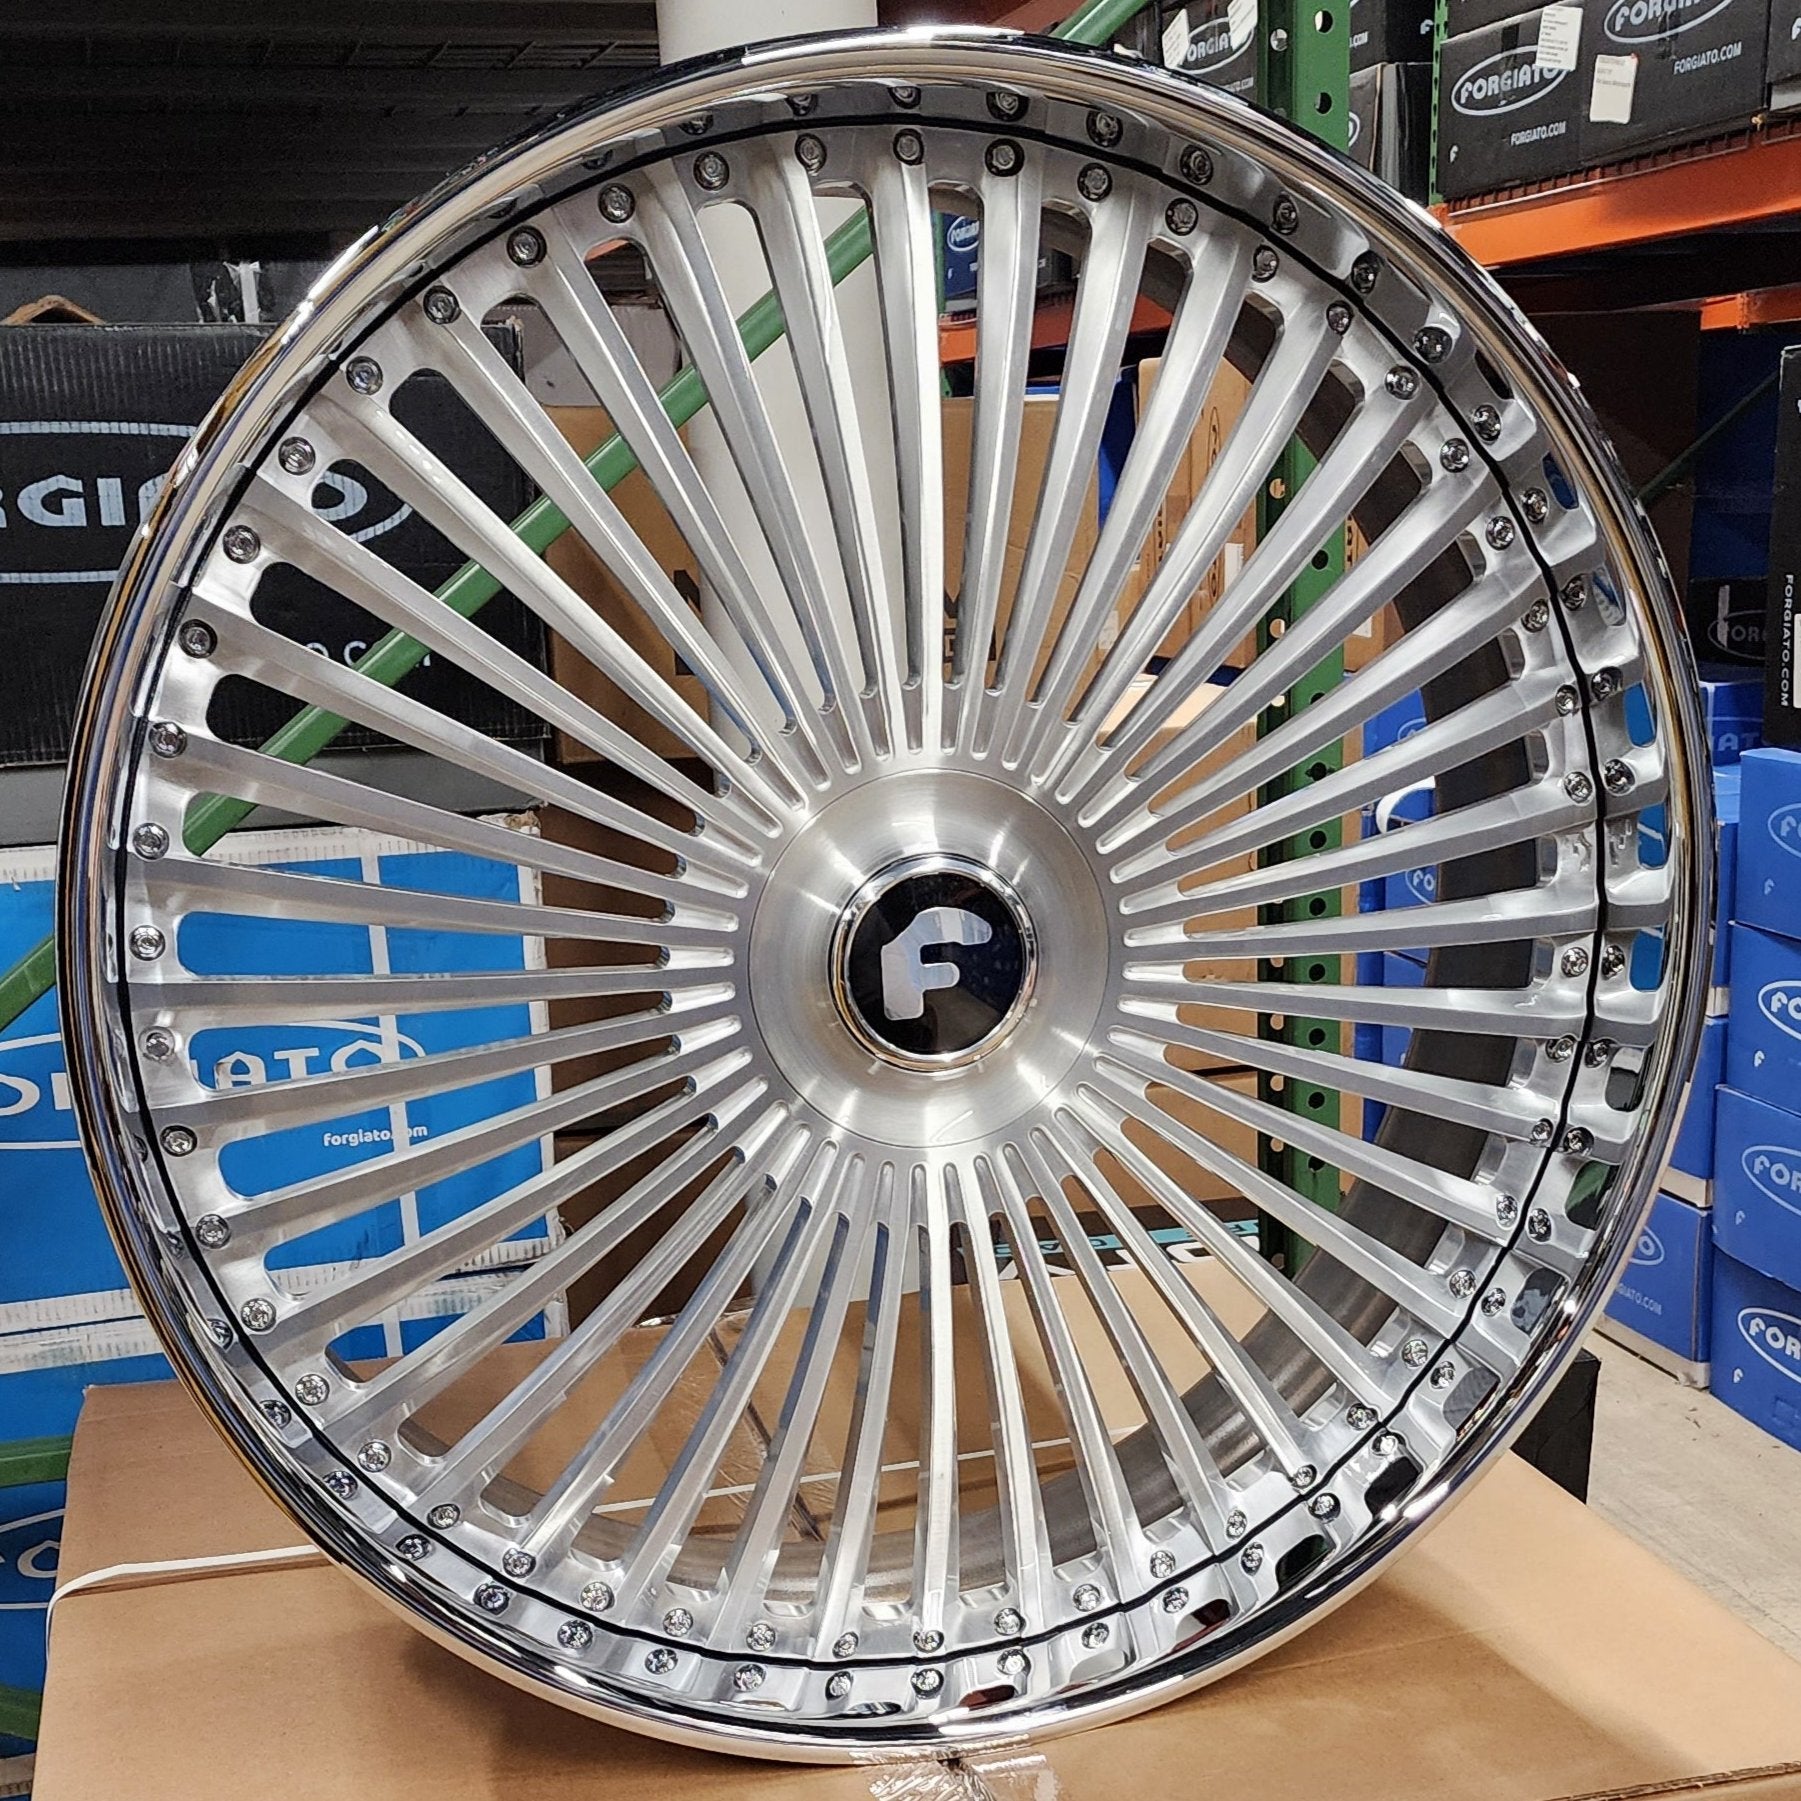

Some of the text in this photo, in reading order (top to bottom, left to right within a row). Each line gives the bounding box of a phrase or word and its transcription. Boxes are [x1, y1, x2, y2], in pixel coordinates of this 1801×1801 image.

[1673, 41, 1743, 76] FORGIATO.COM
[1510, 120, 1567, 146] FORGIATO.COM
[1780, 573, 1794, 707] FORGIATO.COM
